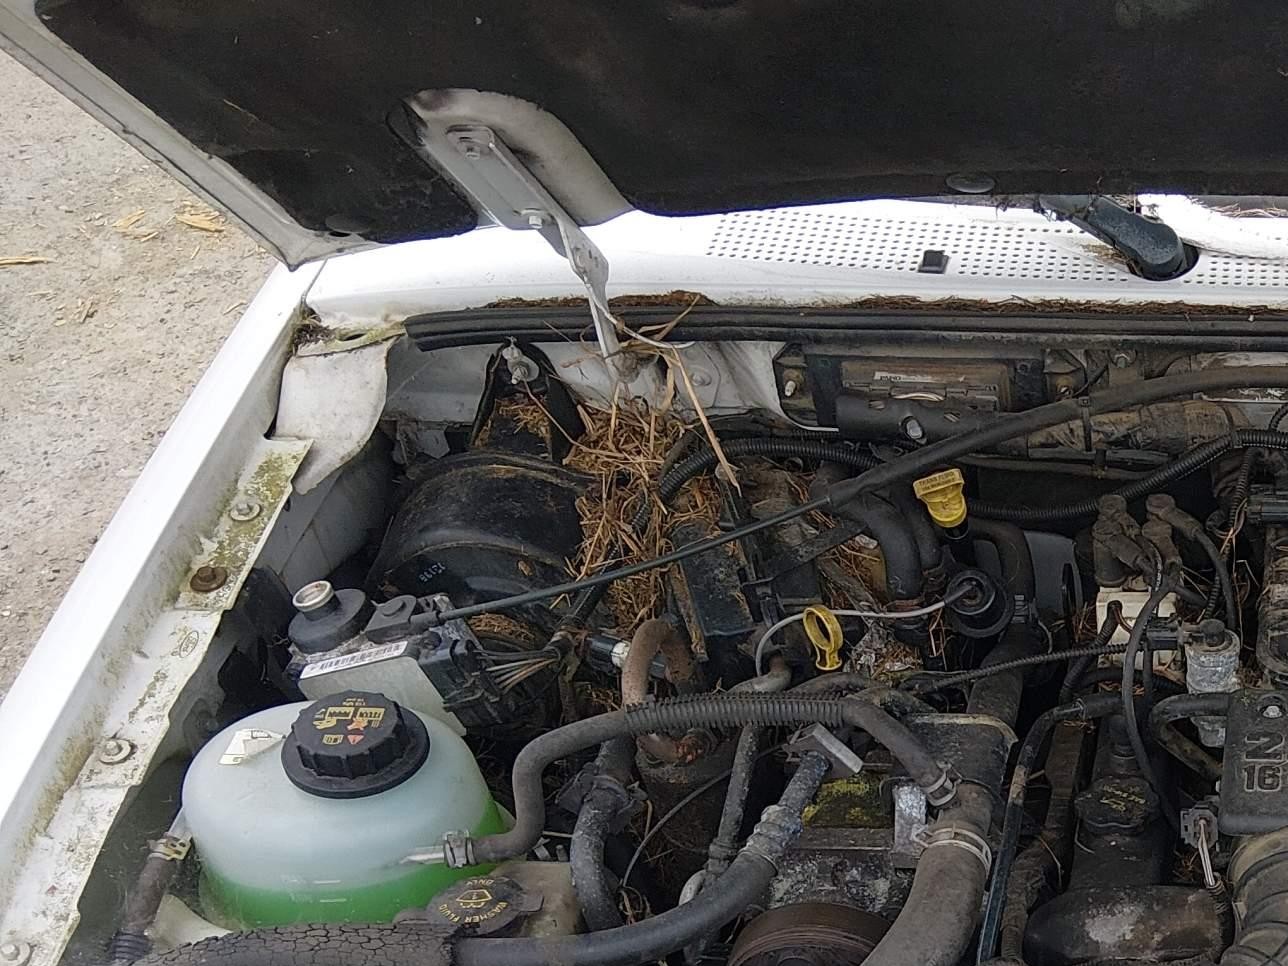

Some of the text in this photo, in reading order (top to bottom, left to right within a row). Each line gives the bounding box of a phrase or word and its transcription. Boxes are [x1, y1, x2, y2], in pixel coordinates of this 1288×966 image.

[1243, 765, 1282, 792] 16
[439, 902, 508, 923] WASHER FLUID
